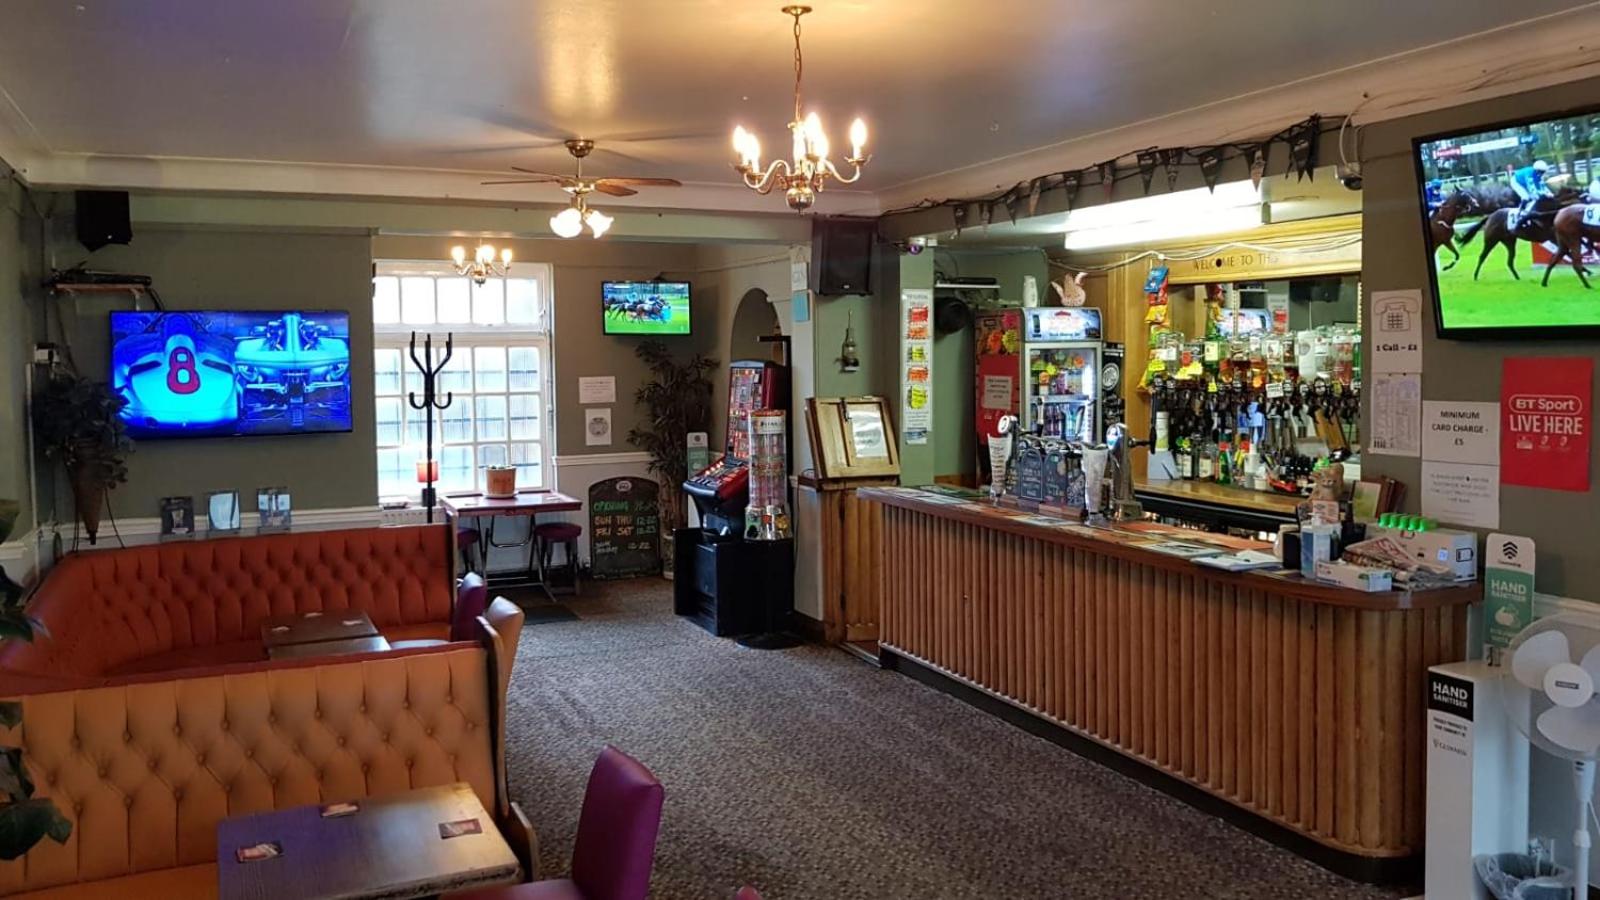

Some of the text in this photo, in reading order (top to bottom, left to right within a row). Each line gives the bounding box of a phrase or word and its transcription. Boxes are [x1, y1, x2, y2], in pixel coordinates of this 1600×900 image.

[1194, 257, 1234, 270] WELCME
[1239, 254, 1253, 265] TO
[1382, 343, 1399, 351] Call
[167, 346, 201, 395] 8
[1516, 398, 1575, 412] BT Sport
[1440, 411, 1480, 419] MINIMUM
[1432, 423, 1451, 432] CARD
[1453, 424, 1484, 433] CHARGE
[1509, 414, 1583, 435] LIVE HERE
[1455, 438, 1464, 446] £5
[1491, 579, 1528, 595] HAND
[1432, 681, 1468, 700] HAND
[1433, 692, 1468, 709] SANITISER
